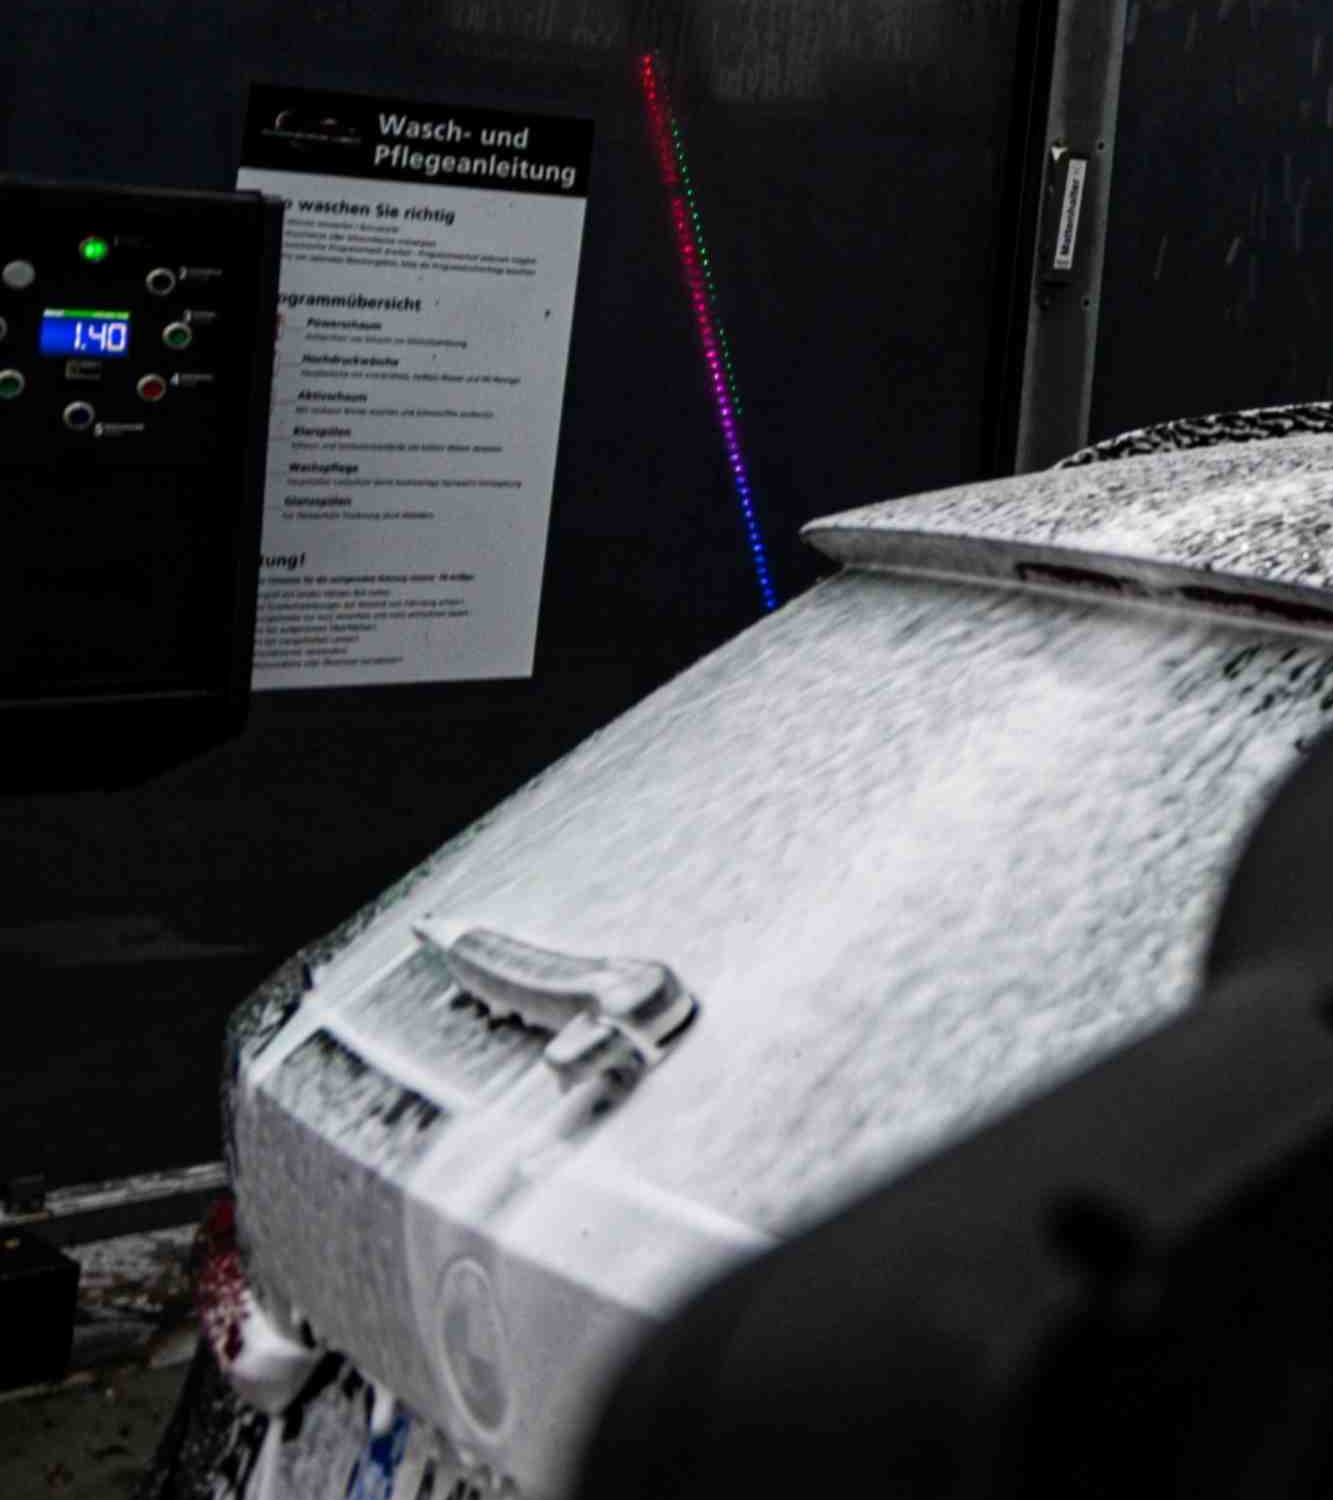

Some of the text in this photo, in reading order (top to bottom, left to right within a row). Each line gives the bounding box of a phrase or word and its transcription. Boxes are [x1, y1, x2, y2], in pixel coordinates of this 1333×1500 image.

[378, 112, 472, 143] Wasch-
[479, 126, 530, 150] und
[373, 144, 577, 190] Pflegeanleitung
[298, 199, 370, 217] waschen
[375, 202, 399, 219] Sie
[404, 206, 456, 226] richtig
[278, 291, 422, 312] ogrammübersicht
[73, 320, 128, 353] 1.40
